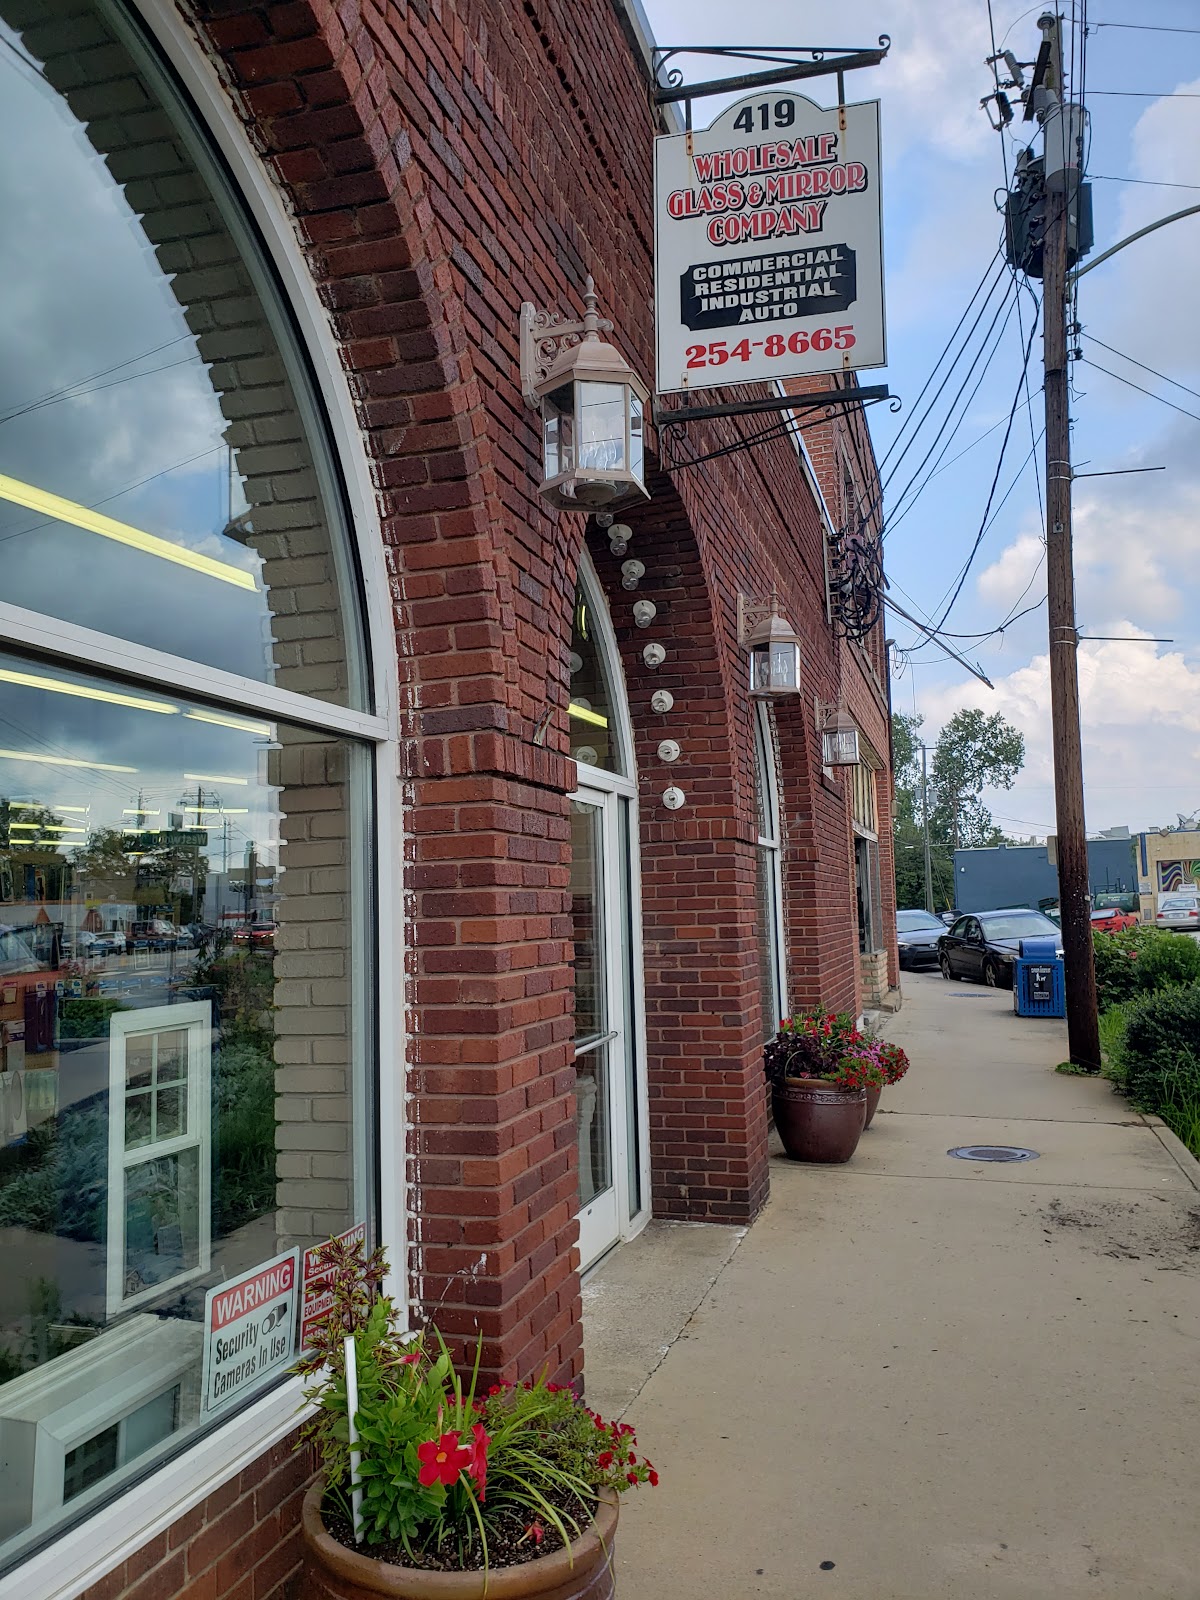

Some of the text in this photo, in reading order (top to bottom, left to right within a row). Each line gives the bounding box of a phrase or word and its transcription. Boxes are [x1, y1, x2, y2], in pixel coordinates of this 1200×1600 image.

[733, 99, 795, 133] 419
[693, 133, 838, 183] WHOLESALE
[667, 162, 868, 220] GLASS & MIRROR
[707, 201, 828, 246] COMPANY
[692, 248, 845, 281] COMMERCIAL
[692, 266, 845, 298] RESIDENTIAL
[700, 281, 838, 312] INDUSTRIAL
[738, 302, 798, 324] AUTO
[685, 325, 856, 369] 254-8665
[308, 1228, 364, 1266] WNING
[216, 1264, 291, 1325] WARNING
[304, 1295, 334, 1317] EQUIPMEN
[216, 1322, 259, 1365] Security
[214, 1356, 256, 1399] Cameras
[259, 1345, 268, 1366] In
[270, 1335, 286, 1362] Use
